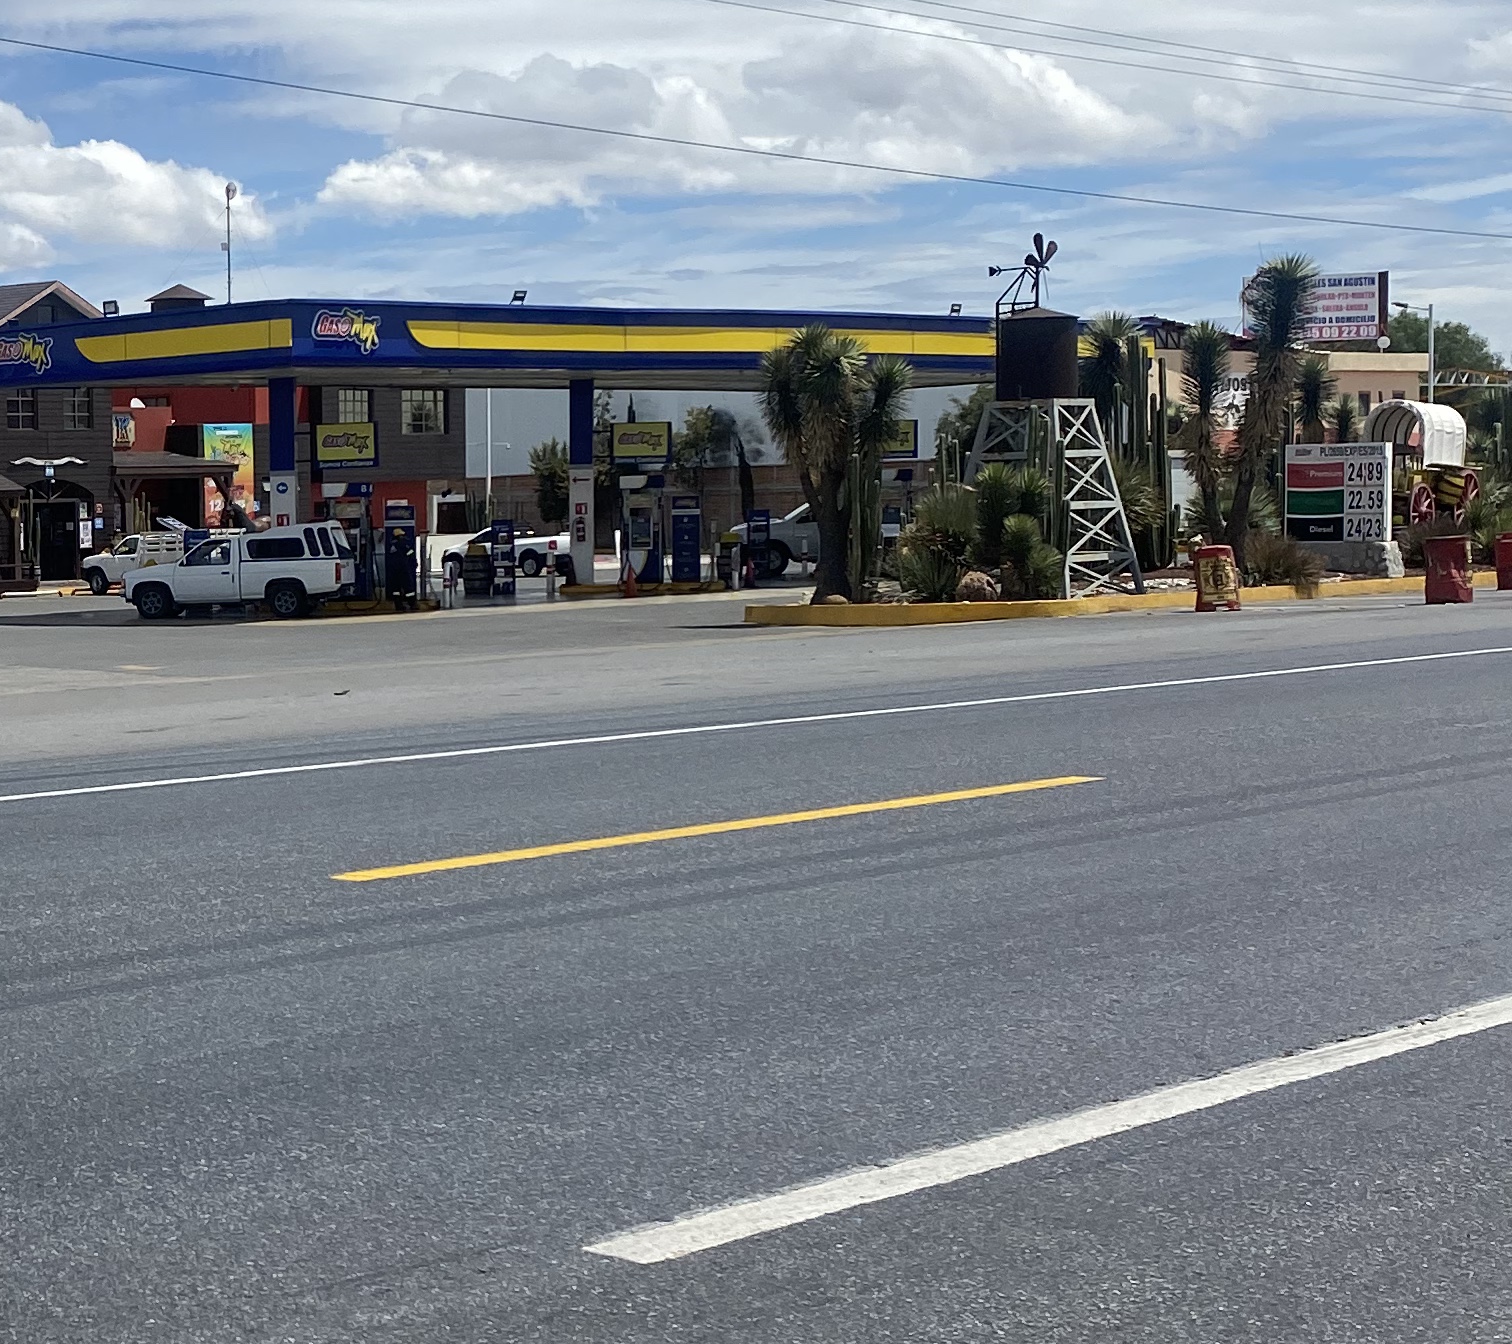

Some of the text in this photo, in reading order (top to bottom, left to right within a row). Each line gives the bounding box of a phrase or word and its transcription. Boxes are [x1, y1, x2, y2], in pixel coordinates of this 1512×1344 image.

[1341, 326, 1357, 337] 22
[1348, 490, 1384, 509] 22.59
[1309, 524, 1334, 533] Diesel
